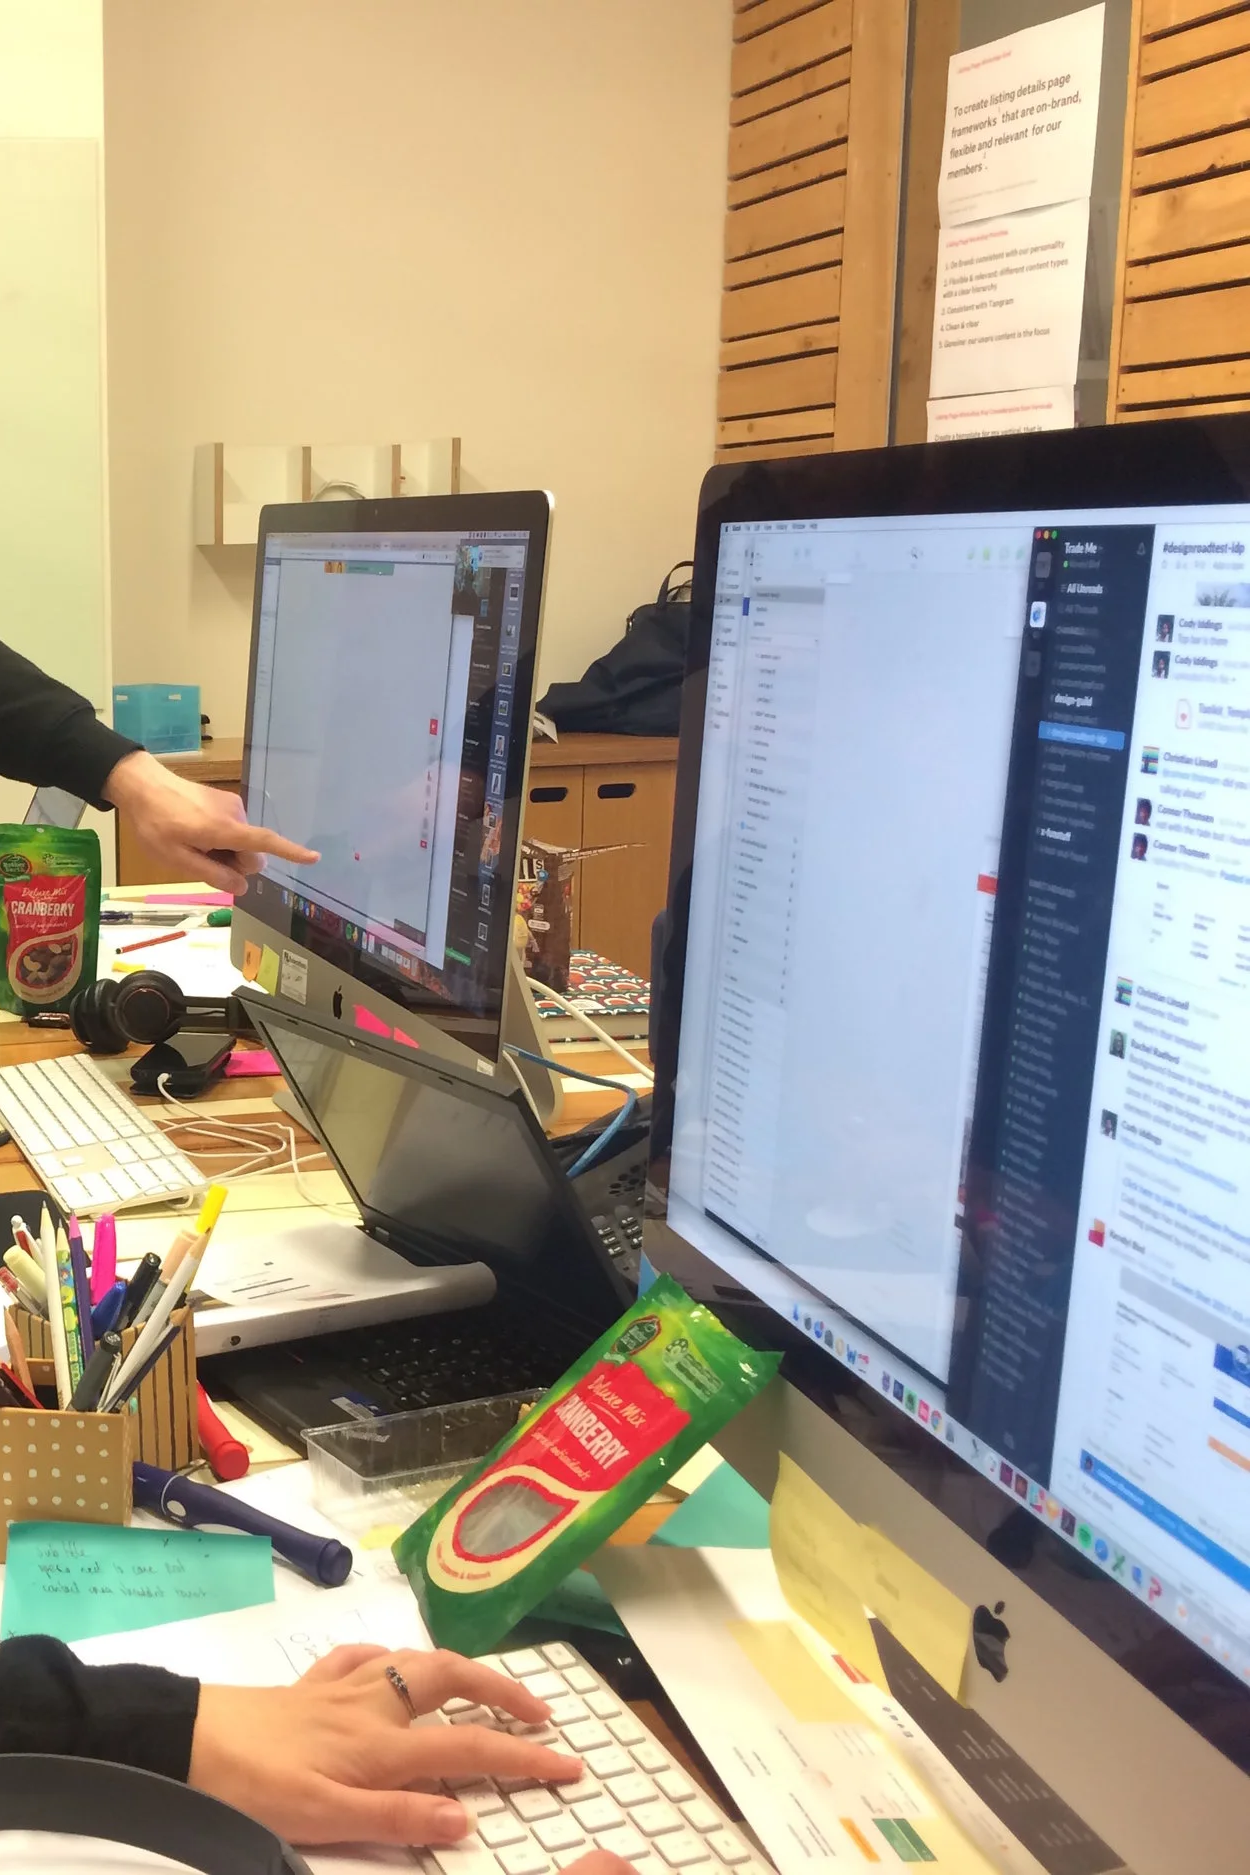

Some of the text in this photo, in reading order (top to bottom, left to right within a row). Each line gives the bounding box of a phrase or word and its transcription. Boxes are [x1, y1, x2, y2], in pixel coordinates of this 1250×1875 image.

[954, 73, 1071, 117] To create listing details page
[951, 116, 997, 138] frameworks
[1002, 110, 1019, 123] that
[1020, 107, 1035, 118] are
[950, 120, 1062, 159] flexible and relevant for our
[1051, 258, 1068, 268] types
[1034, 327, 1050, 335] focus
[1065, 542, 1097, 554] Trade Me
[11, 901, 75, 917] CRANBERRY
[620, 1402, 647, 1429] Mix
